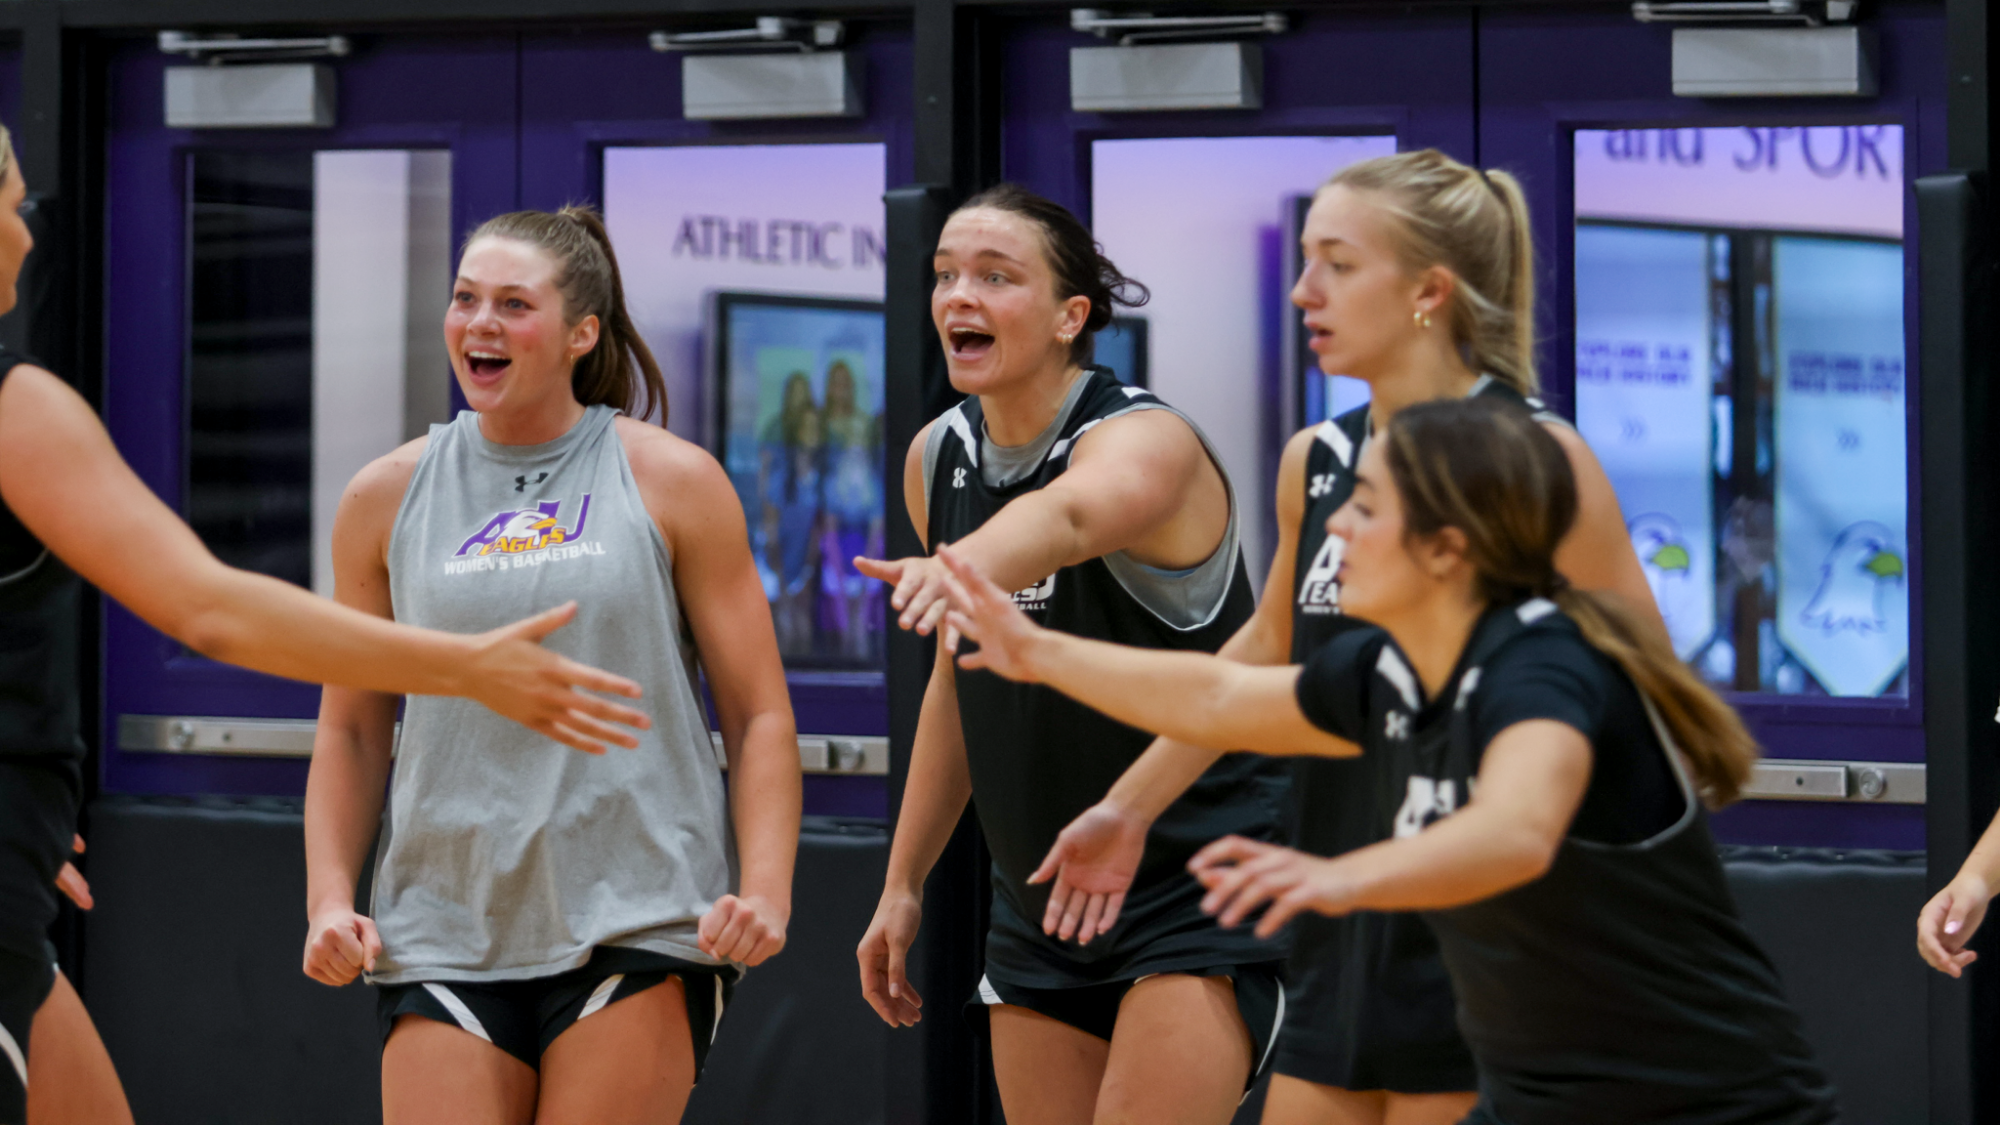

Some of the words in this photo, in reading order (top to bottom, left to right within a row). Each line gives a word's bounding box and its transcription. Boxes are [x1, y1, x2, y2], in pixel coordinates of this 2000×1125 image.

[671, 214, 844, 270] ATHLETIC
[444, 556, 509, 575] WOMEN'S
[512, 541, 606, 568] BASKETBALL
[476, 527, 568, 556] EAGLES
